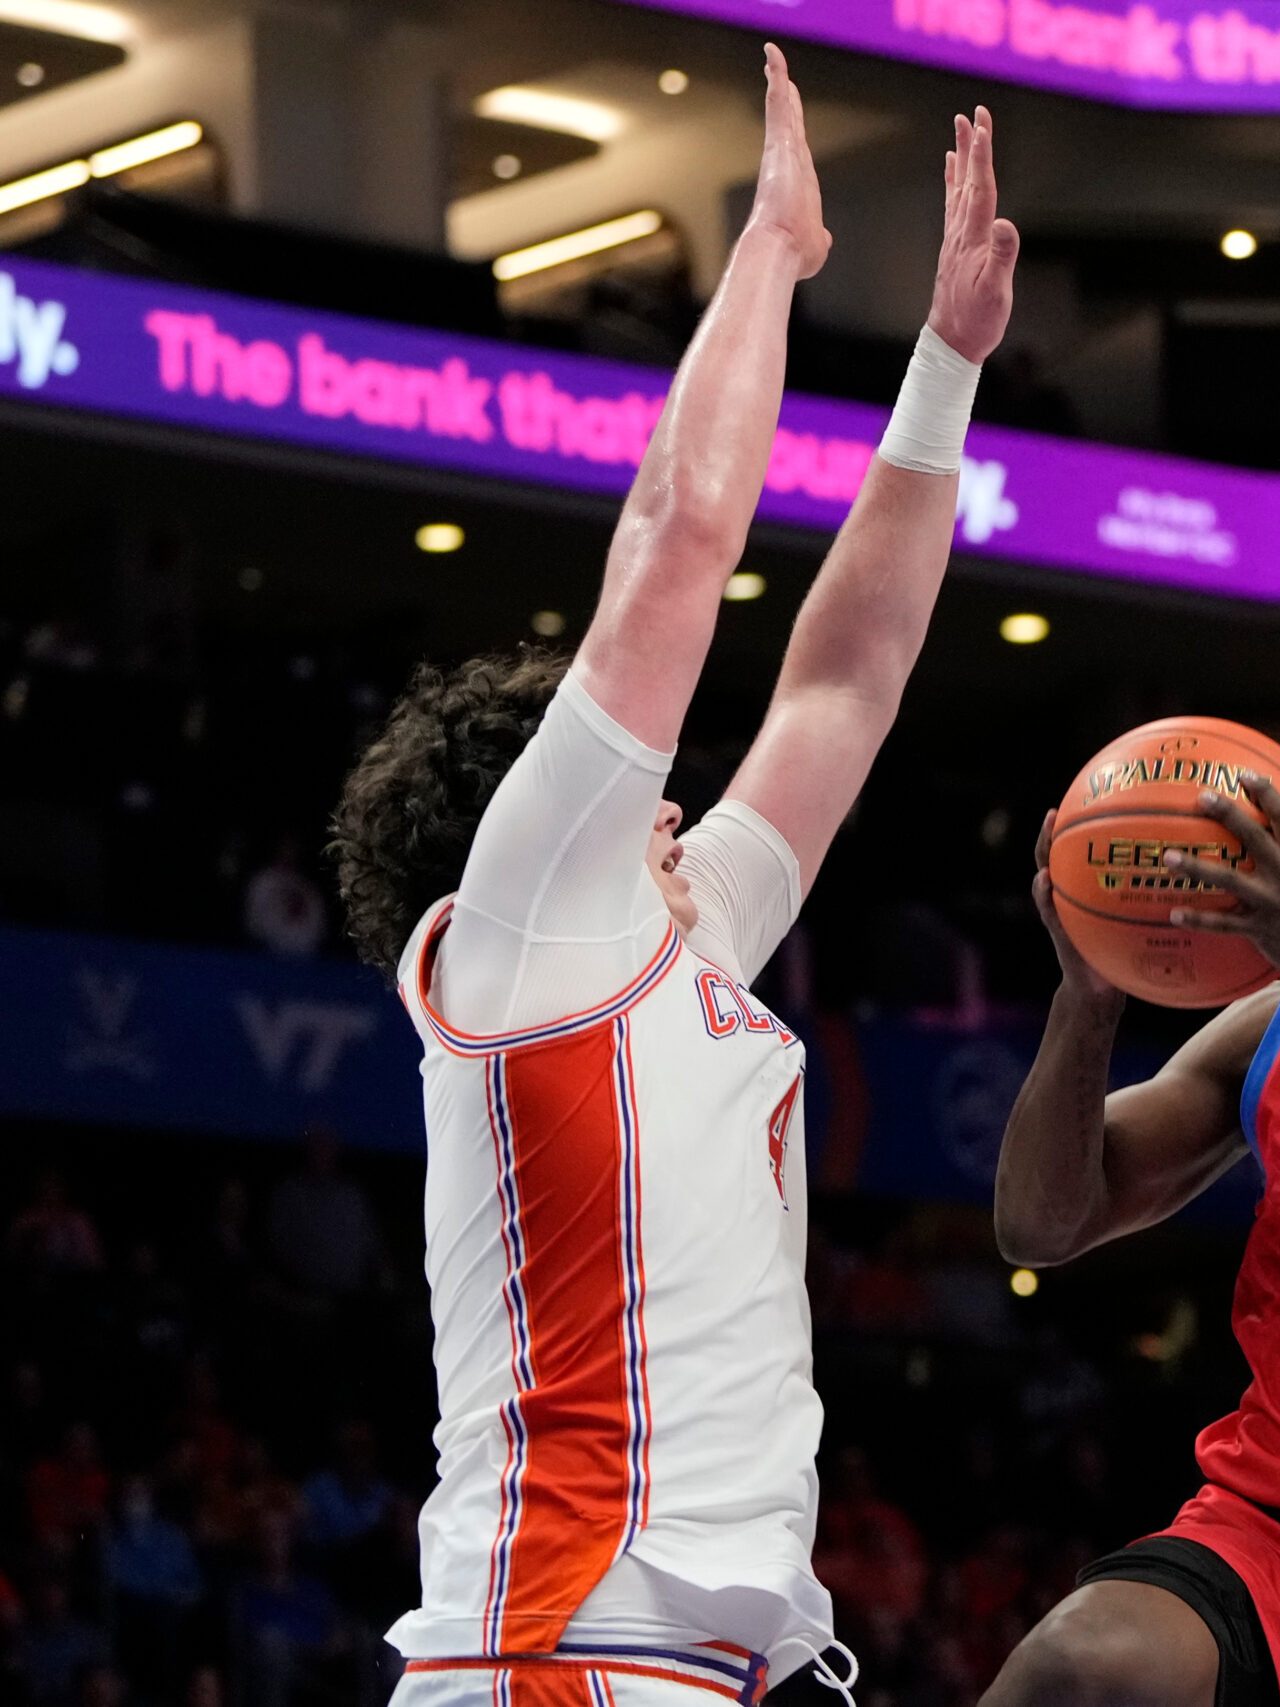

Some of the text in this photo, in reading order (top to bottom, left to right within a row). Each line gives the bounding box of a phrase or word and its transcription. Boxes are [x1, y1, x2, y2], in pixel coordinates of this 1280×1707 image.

[1006, 0, 1182, 81] bank
[145, 309, 292, 407] The
[297, 333, 492, 441] bank
[1083, 756, 1272, 806] SPALDIN
